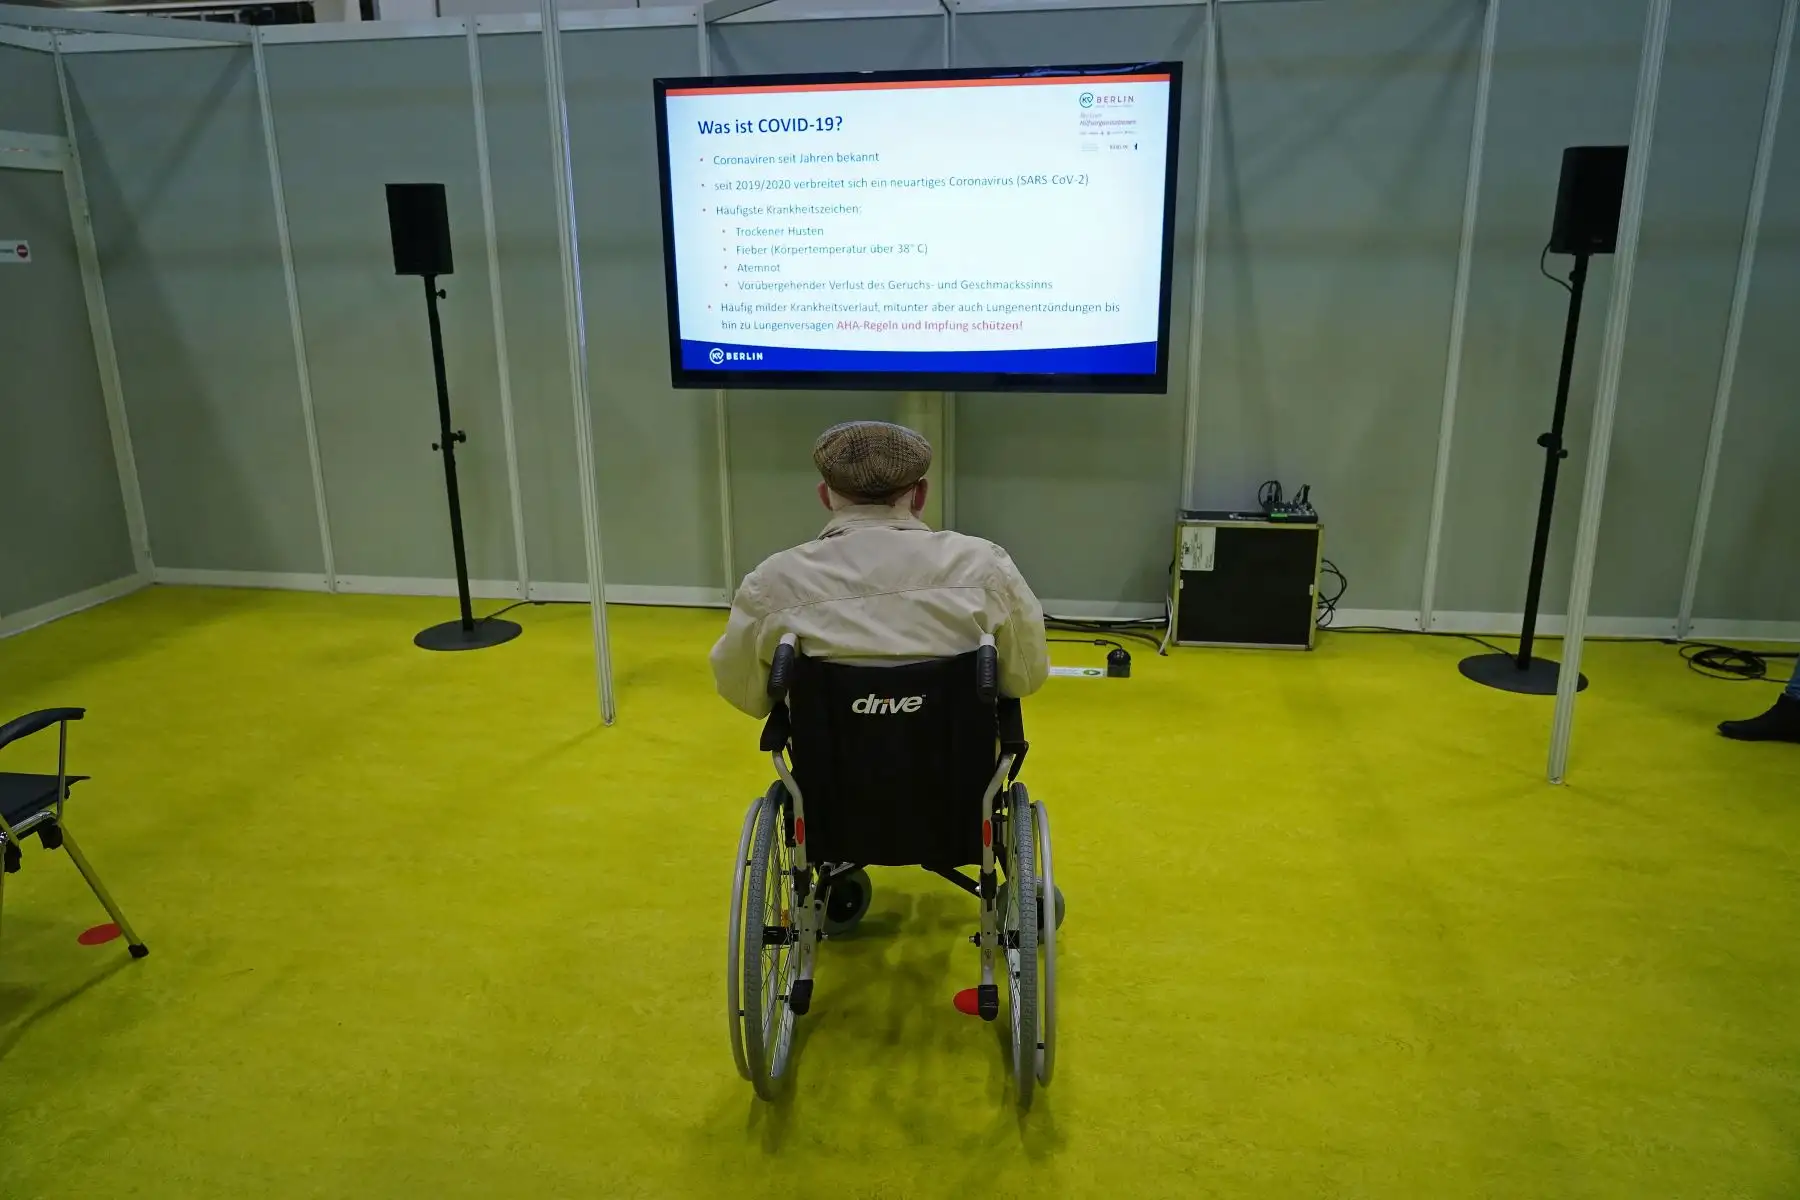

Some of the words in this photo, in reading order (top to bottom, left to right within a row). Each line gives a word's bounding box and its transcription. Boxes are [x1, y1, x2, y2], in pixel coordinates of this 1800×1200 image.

[1096, 95, 1134, 104] BERLIN
[697, 120, 730, 135] Was
[735, 119, 754, 134] ist
[758, 115, 843, 133] COVID-19?
[713, 153, 775, 165] Coronaviren
[778, 153, 797, 164] seit
[799, 153, 834, 164] Jahren
[836, 152, 880, 163] bekannt
[713, 181, 732, 191] seit
[735, 179, 791, 191] 2019/2020
[794, 179, 845, 190] verbreitet
[847, 177, 868, 188] sich
[871, 178, 887, 188] ein
[890, 176, 946, 189] neuartiges
[949, 175, 1014, 187] Coronavirus
[766, 203, 862, 215] Krankheitszeichen:
[735, 227, 785, 237] Trockener
[787, 226, 824, 236] Husten
[736, 245, 767, 255] Fieber
[870, 244, 894, 254] über
[737, 263, 781, 273] Atemnot
[737, 280, 826, 292] Vorübergehender
[829, 280, 864, 290] Verlust
[867, 280, 885, 290] des
[888, 280, 935, 290] Geruchs-
[938, 280, 958, 290] und
[960, 279, 1053, 290] Geschmackssinns
[755, 302, 787, 312] milder
[790, 302, 881, 313] Krankheitsverlauf,
[883, 302, 929, 312] mitunter
[931, 302, 954, 312] aber
[958, 302, 983, 312] auch
[986, 302, 1102, 315] Lungenentzündungen
[1105, 302, 1120, 312] bis
[721, 320, 737, 330] hin
[740, 321, 751, 330] zu
[753, 320, 834, 331] Lungenversagen
[836, 319, 898, 332] AHA-Regeln
[901, 319, 922, 330] und
[924, 319, 969, 332] Impfung
[971, 319, 1024, 331] schützen!
[726, 351, 764, 361] BERLIN
[851, 693, 923, 714] drive
